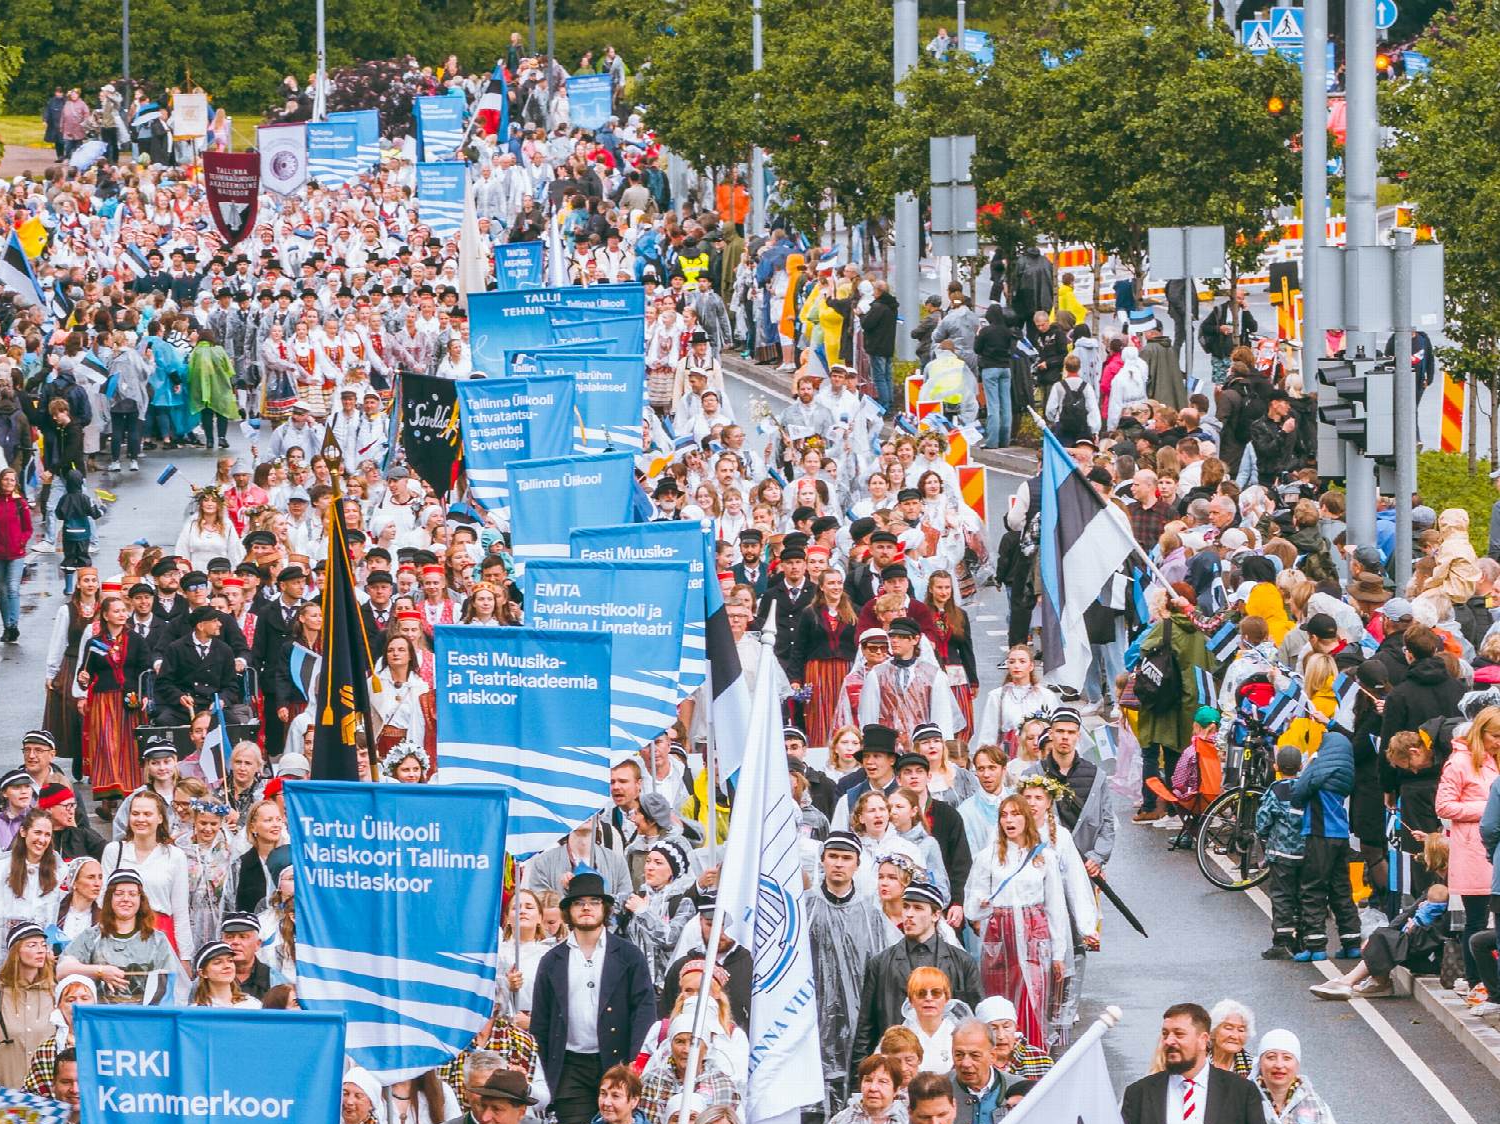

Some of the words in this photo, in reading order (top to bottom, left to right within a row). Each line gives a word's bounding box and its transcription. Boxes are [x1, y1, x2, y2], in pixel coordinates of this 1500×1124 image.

[467, 398, 510, 410] Tallinna
[512, 393, 554, 407] Ülikooli
[468, 410, 539, 424] rahvatantsu-
[469, 423, 523, 438] ansambel
[471, 439, 525, 453] Soveldaja
[516, 478, 561, 492] Tallinna
[563, 473, 602, 487] Ülikool
[580, 547, 614, 560] Eesti
[616, 544, 679, 560] Muusika-
[535, 583, 581, 598] EMTA
[533, 600, 646, 618] lavakunstikooli
[647, 604, 662, 621] ja
[533, 616, 588, 631] Tallinna
[593, 617, 673, 636] Linnateatri
[447, 651, 488, 667] Eesti
[492, 652, 567, 670] Muusika-
[447, 671, 463, 688] ja
[466, 670, 598, 690] Teatriakadeemia
[448, 690, 518, 706] naiskoor
[300, 816, 356, 839] Tartu
[361, 815, 440, 842] Ülikooli
[304, 842, 401, 867] Naiskoori
[407, 848, 490, 870] Tallinna
[304, 865, 433, 893] Vilistlaskoor
[96, 1049, 171, 1078] ERKI
[98, 1086, 295, 1119] Kammerkoor
